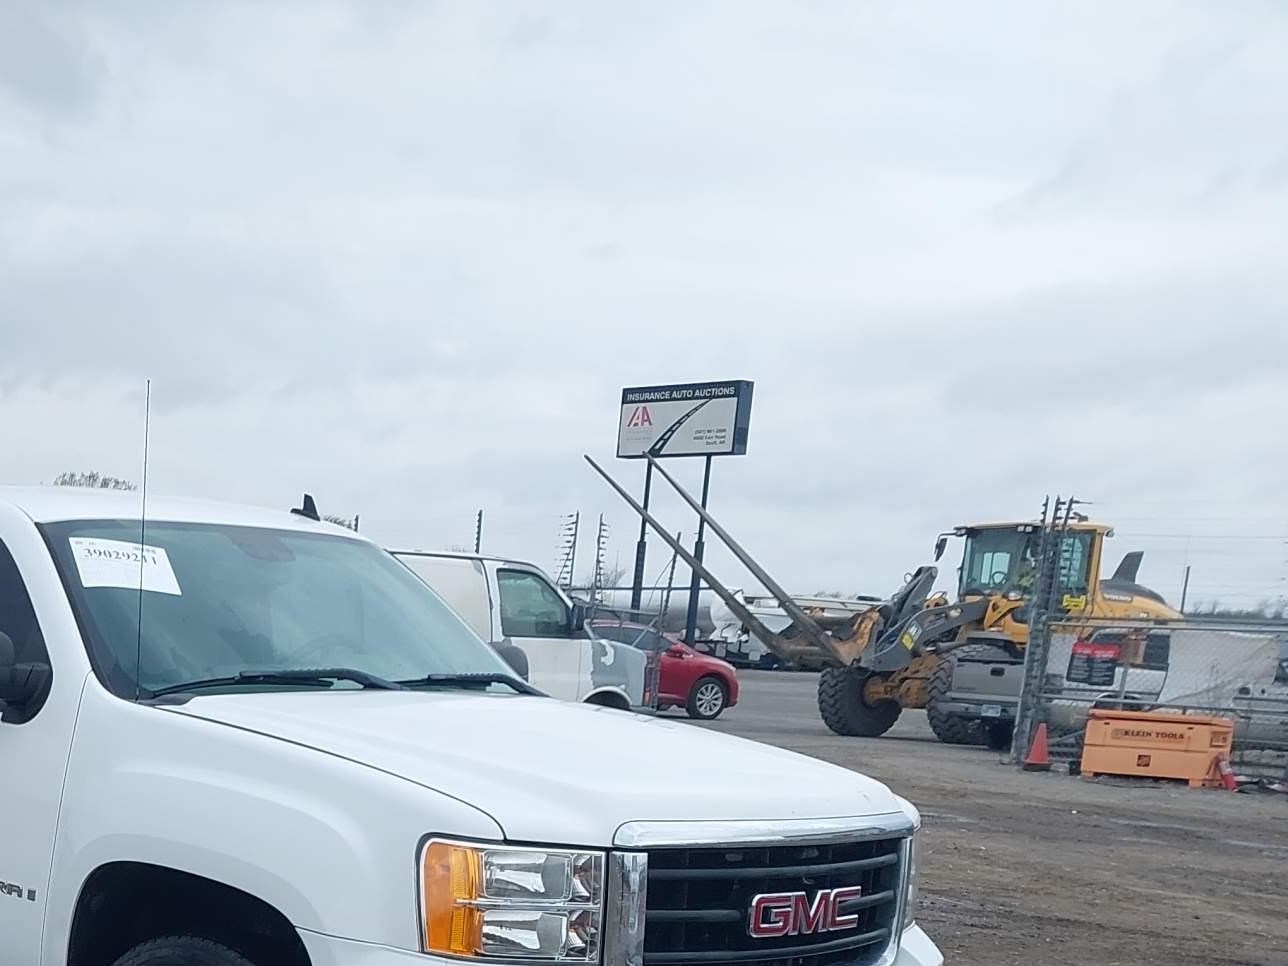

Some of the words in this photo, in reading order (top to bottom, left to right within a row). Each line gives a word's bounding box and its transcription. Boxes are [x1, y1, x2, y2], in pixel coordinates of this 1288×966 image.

[627, 391, 670, 401] INSURANCE
[671, 390, 693, 399] AUTO
[694, 387, 735, 397] AUCTIONS
[84, 547, 158, 565] 39029211
[1124, 730, 1152, 738] KLEIN
[750, 886, 862, 938] GMC
